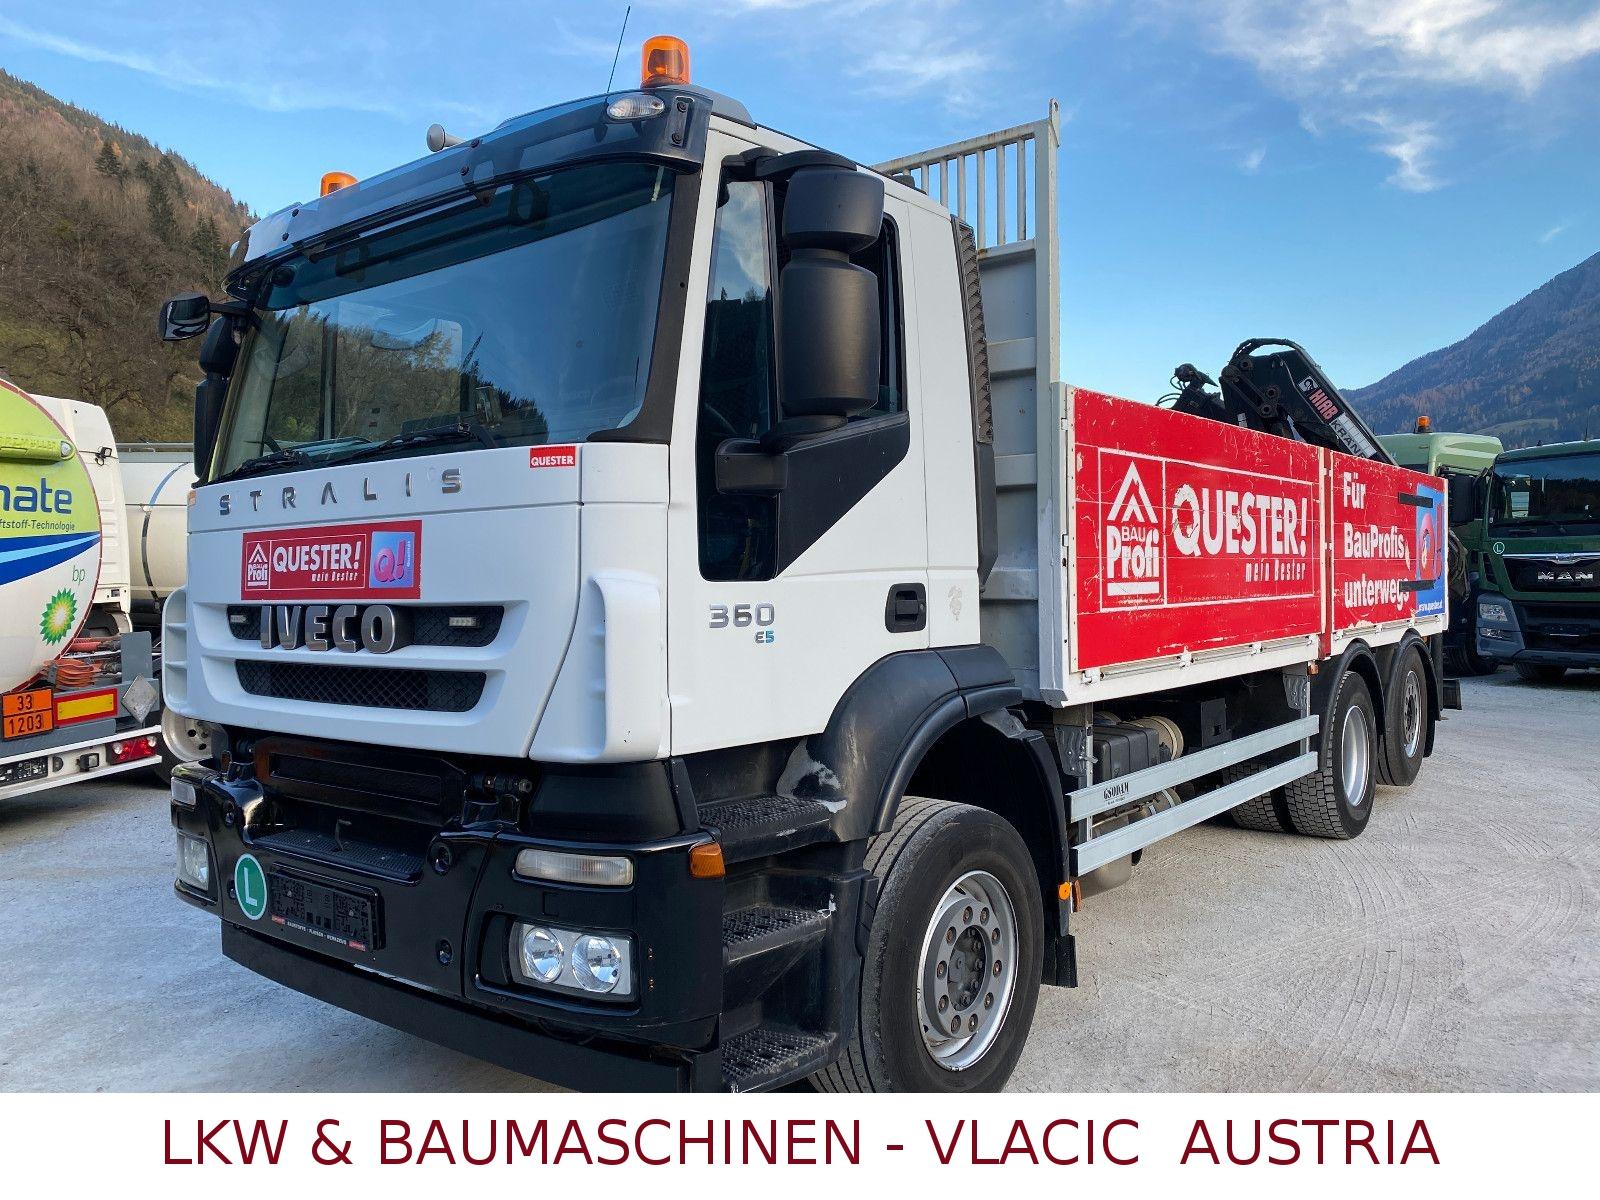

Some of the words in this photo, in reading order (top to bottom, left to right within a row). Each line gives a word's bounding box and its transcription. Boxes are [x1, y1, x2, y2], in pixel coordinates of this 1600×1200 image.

[1309, 388, 1339, 420] HIAB
[531, 455, 575, 467] QUESTER
[219, 467, 462, 516] STRALIS
[1343, 472, 1366, 509] Für
[1172, 483, 1307, 557] QUESTER!
[1121, 525, 1146, 542] BAU
[1343, 521, 1405, 559] BauProfis
[272, 541, 362, 573] QUESTER!
[1107, 525, 1160, 579] Profi
[72, 565, 86, 585] bp
[247, 564, 268, 582] Profi
[1245, 561, 1270, 582] mein
[1274, 559, 1306, 581] Bester
[1537, 571, 1594, 580] MAN
[709, 602, 775, 628] 360
[260, 604, 395, 654] IVECO
[754, 630, 775, 644] E5
[17, 694, 33, 711] 33
[9, 714, 43, 735] 1203
[243, 867, 258, 906] L
